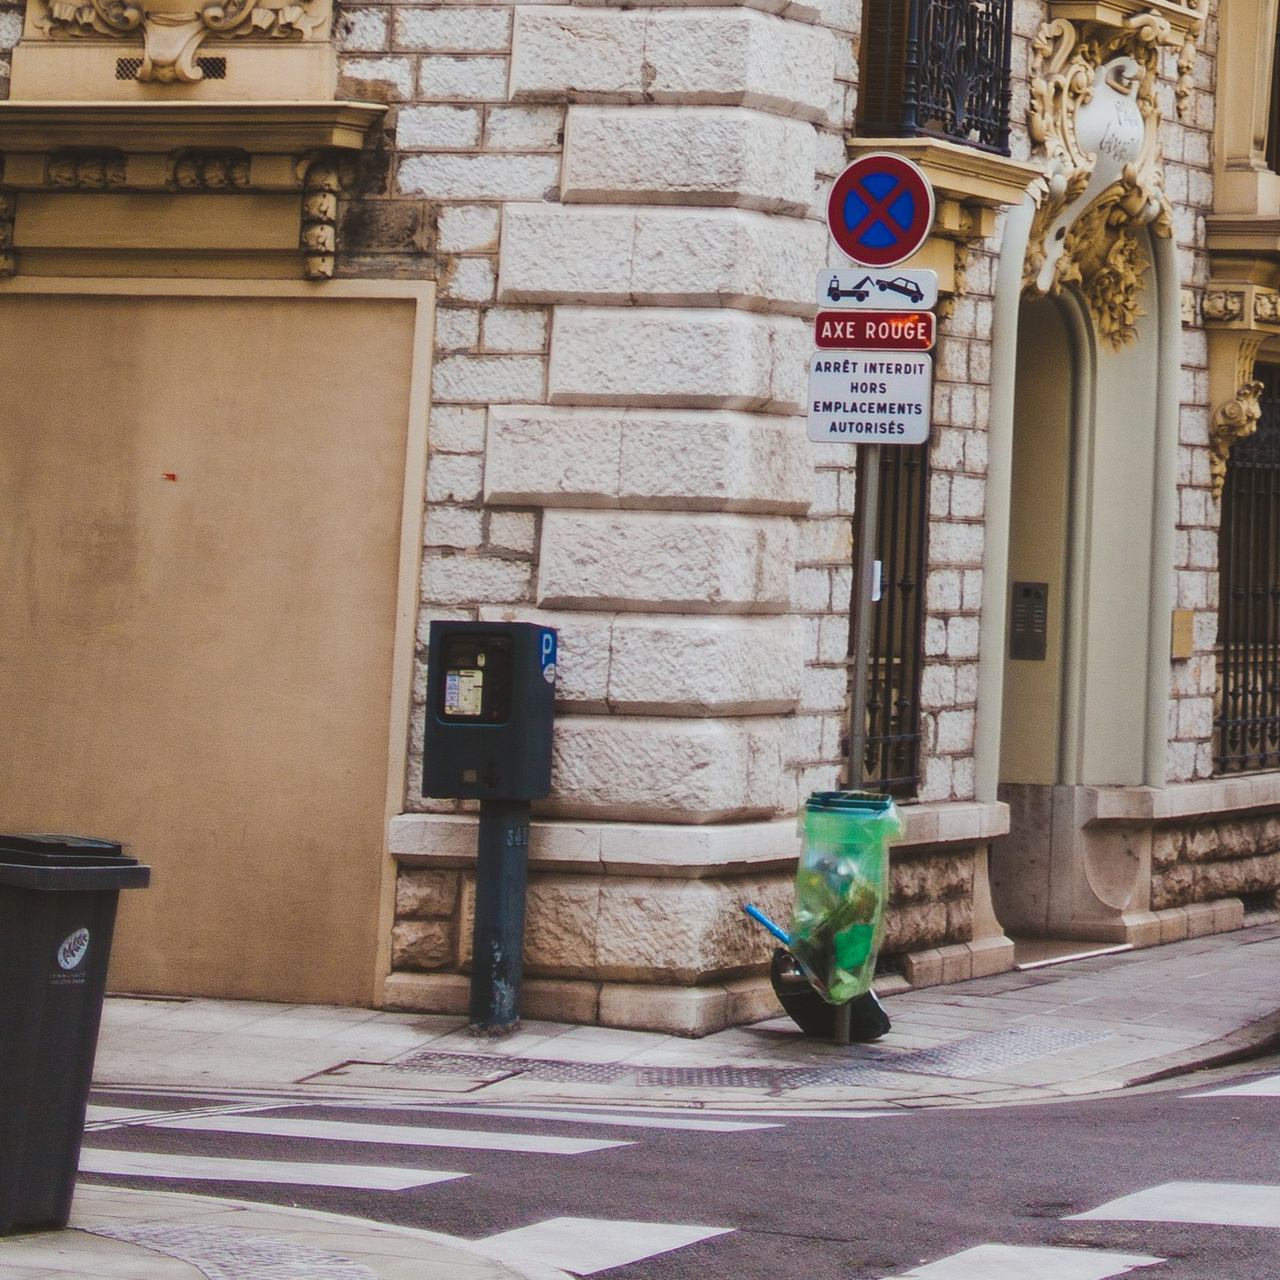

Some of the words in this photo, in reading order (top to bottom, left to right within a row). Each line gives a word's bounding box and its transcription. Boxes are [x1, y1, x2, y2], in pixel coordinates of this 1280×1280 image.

[821, 322, 855, 338] AXE
[865, 322, 927, 340] ROUGE
[815, 359, 858, 373] ARRÊT
[864, 362, 925, 375] INTERDIT
[850, 382, 887, 394] HORS
[813, 401, 923, 415] EMPLACEMENTS
[829, 421, 905, 434] AUTORISÉS
[542, 633, 553, 665] P
